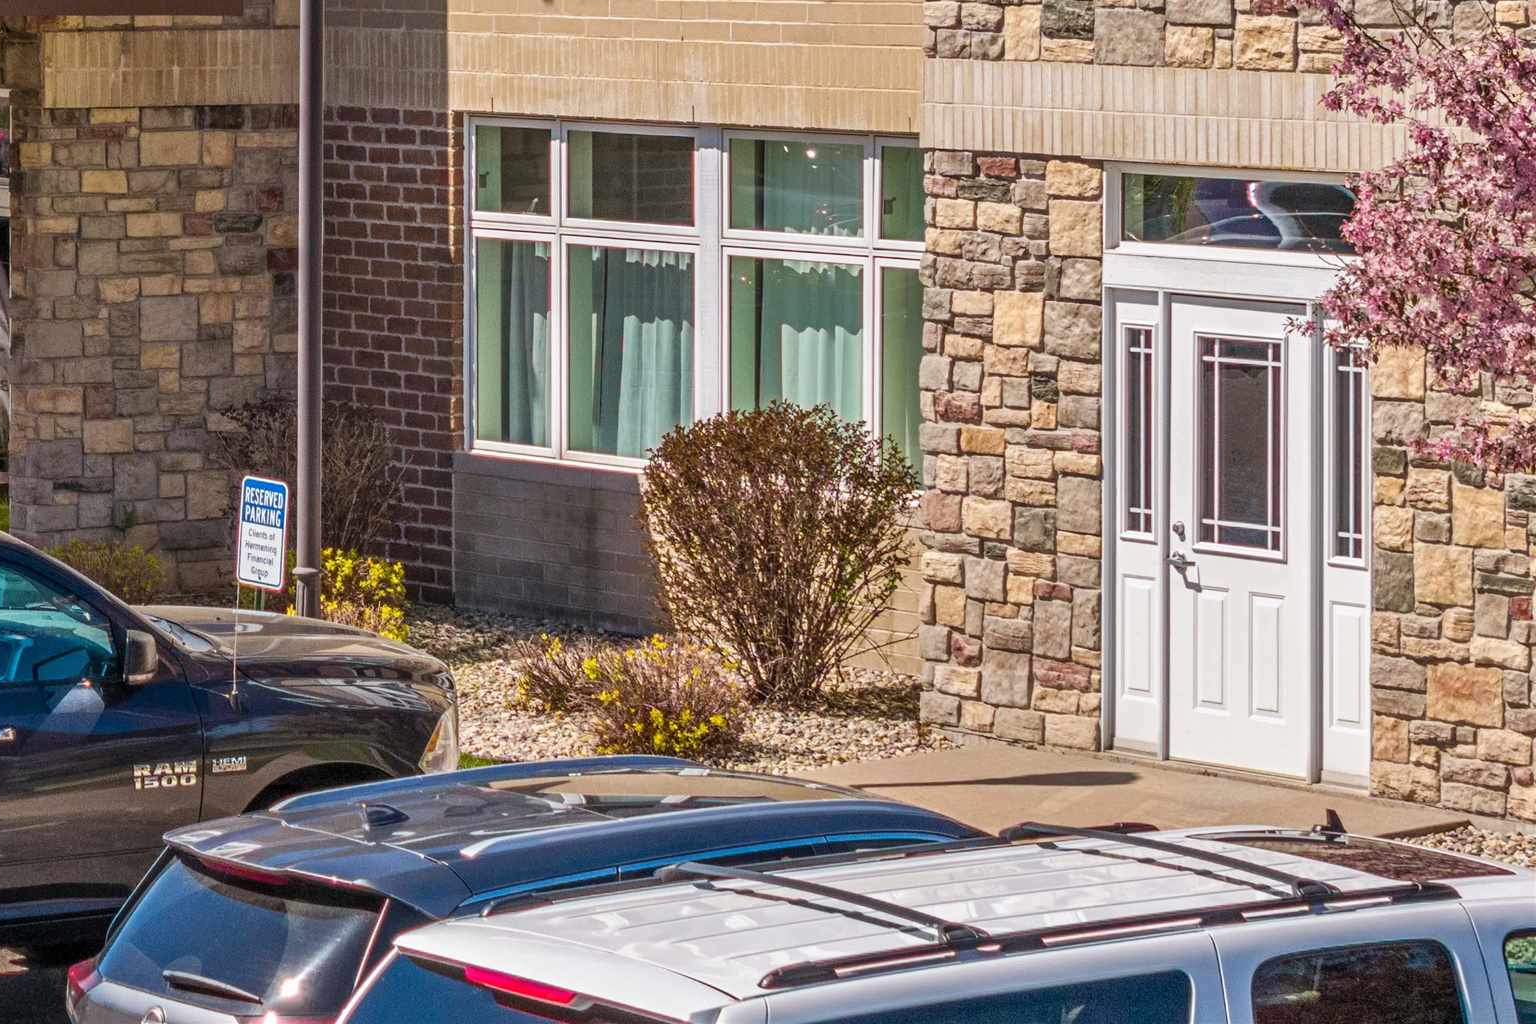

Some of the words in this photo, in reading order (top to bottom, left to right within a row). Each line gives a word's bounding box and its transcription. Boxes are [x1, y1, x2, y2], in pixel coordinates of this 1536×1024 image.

[245, 486, 284, 509] RESERVED
[245, 505, 282, 527] PARKING
[248, 528, 268, 540] Clients
[269, 533, 276, 541] of
[247, 553, 274, 566] Financial
[250, 566, 269, 578] Group
[133, 760, 197, 777] RAM
[212, 756, 247, 768] HEMI
[134, 773, 197, 790] 1500
